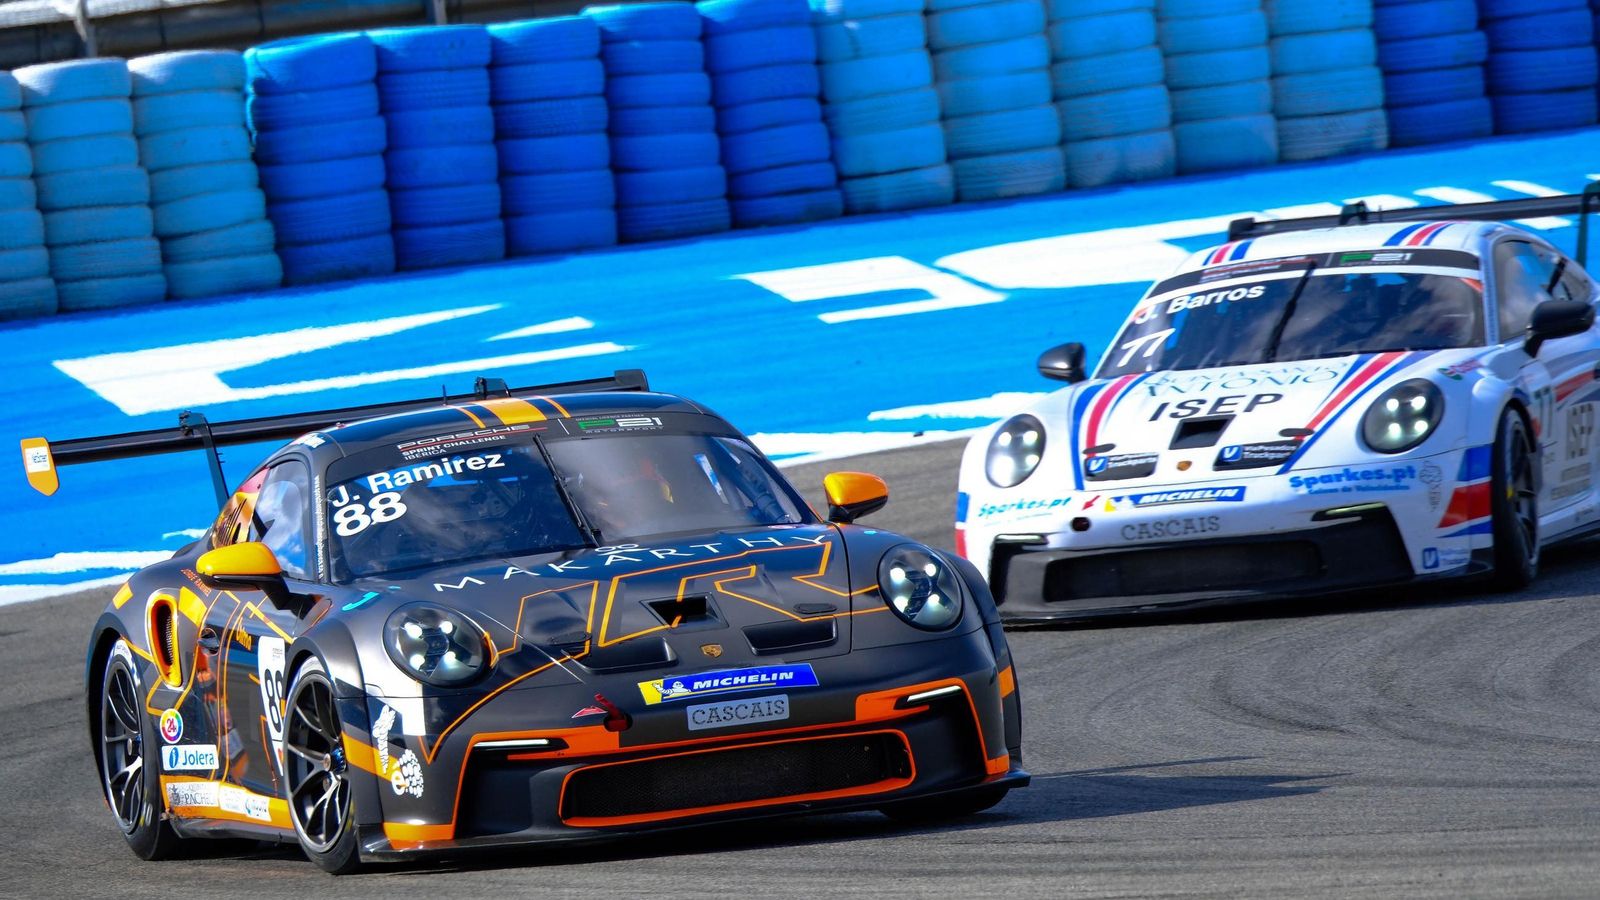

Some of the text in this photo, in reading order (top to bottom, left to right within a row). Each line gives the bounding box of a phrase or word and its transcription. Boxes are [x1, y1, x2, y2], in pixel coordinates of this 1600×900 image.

[1166, 285, 1266, 314] Barros
[1117, 327, 1177, 368] 77
[1149, 393, 1284, 422] ISEP
[397, 424, 530, 450] PORSCHE
[402, 434, 506, 456] SPRINT CHALLENGE
[331, 452, 506, 508] J. Ramirez
[1289, 465, 1417, 489] Sparkes.pt
[1139, 488, 1239, 505] MICHELIN
[333, 491, 408, 537] 88
[1121, 516, 1221, 541] CASCAIS
[433, 534, 827, 593] MAKARTHY
[692, 671, 794, 690] MICHELIN
[692, 699, 785, 726] CASCAIS
[182, 750, 214, 766] Jolera
